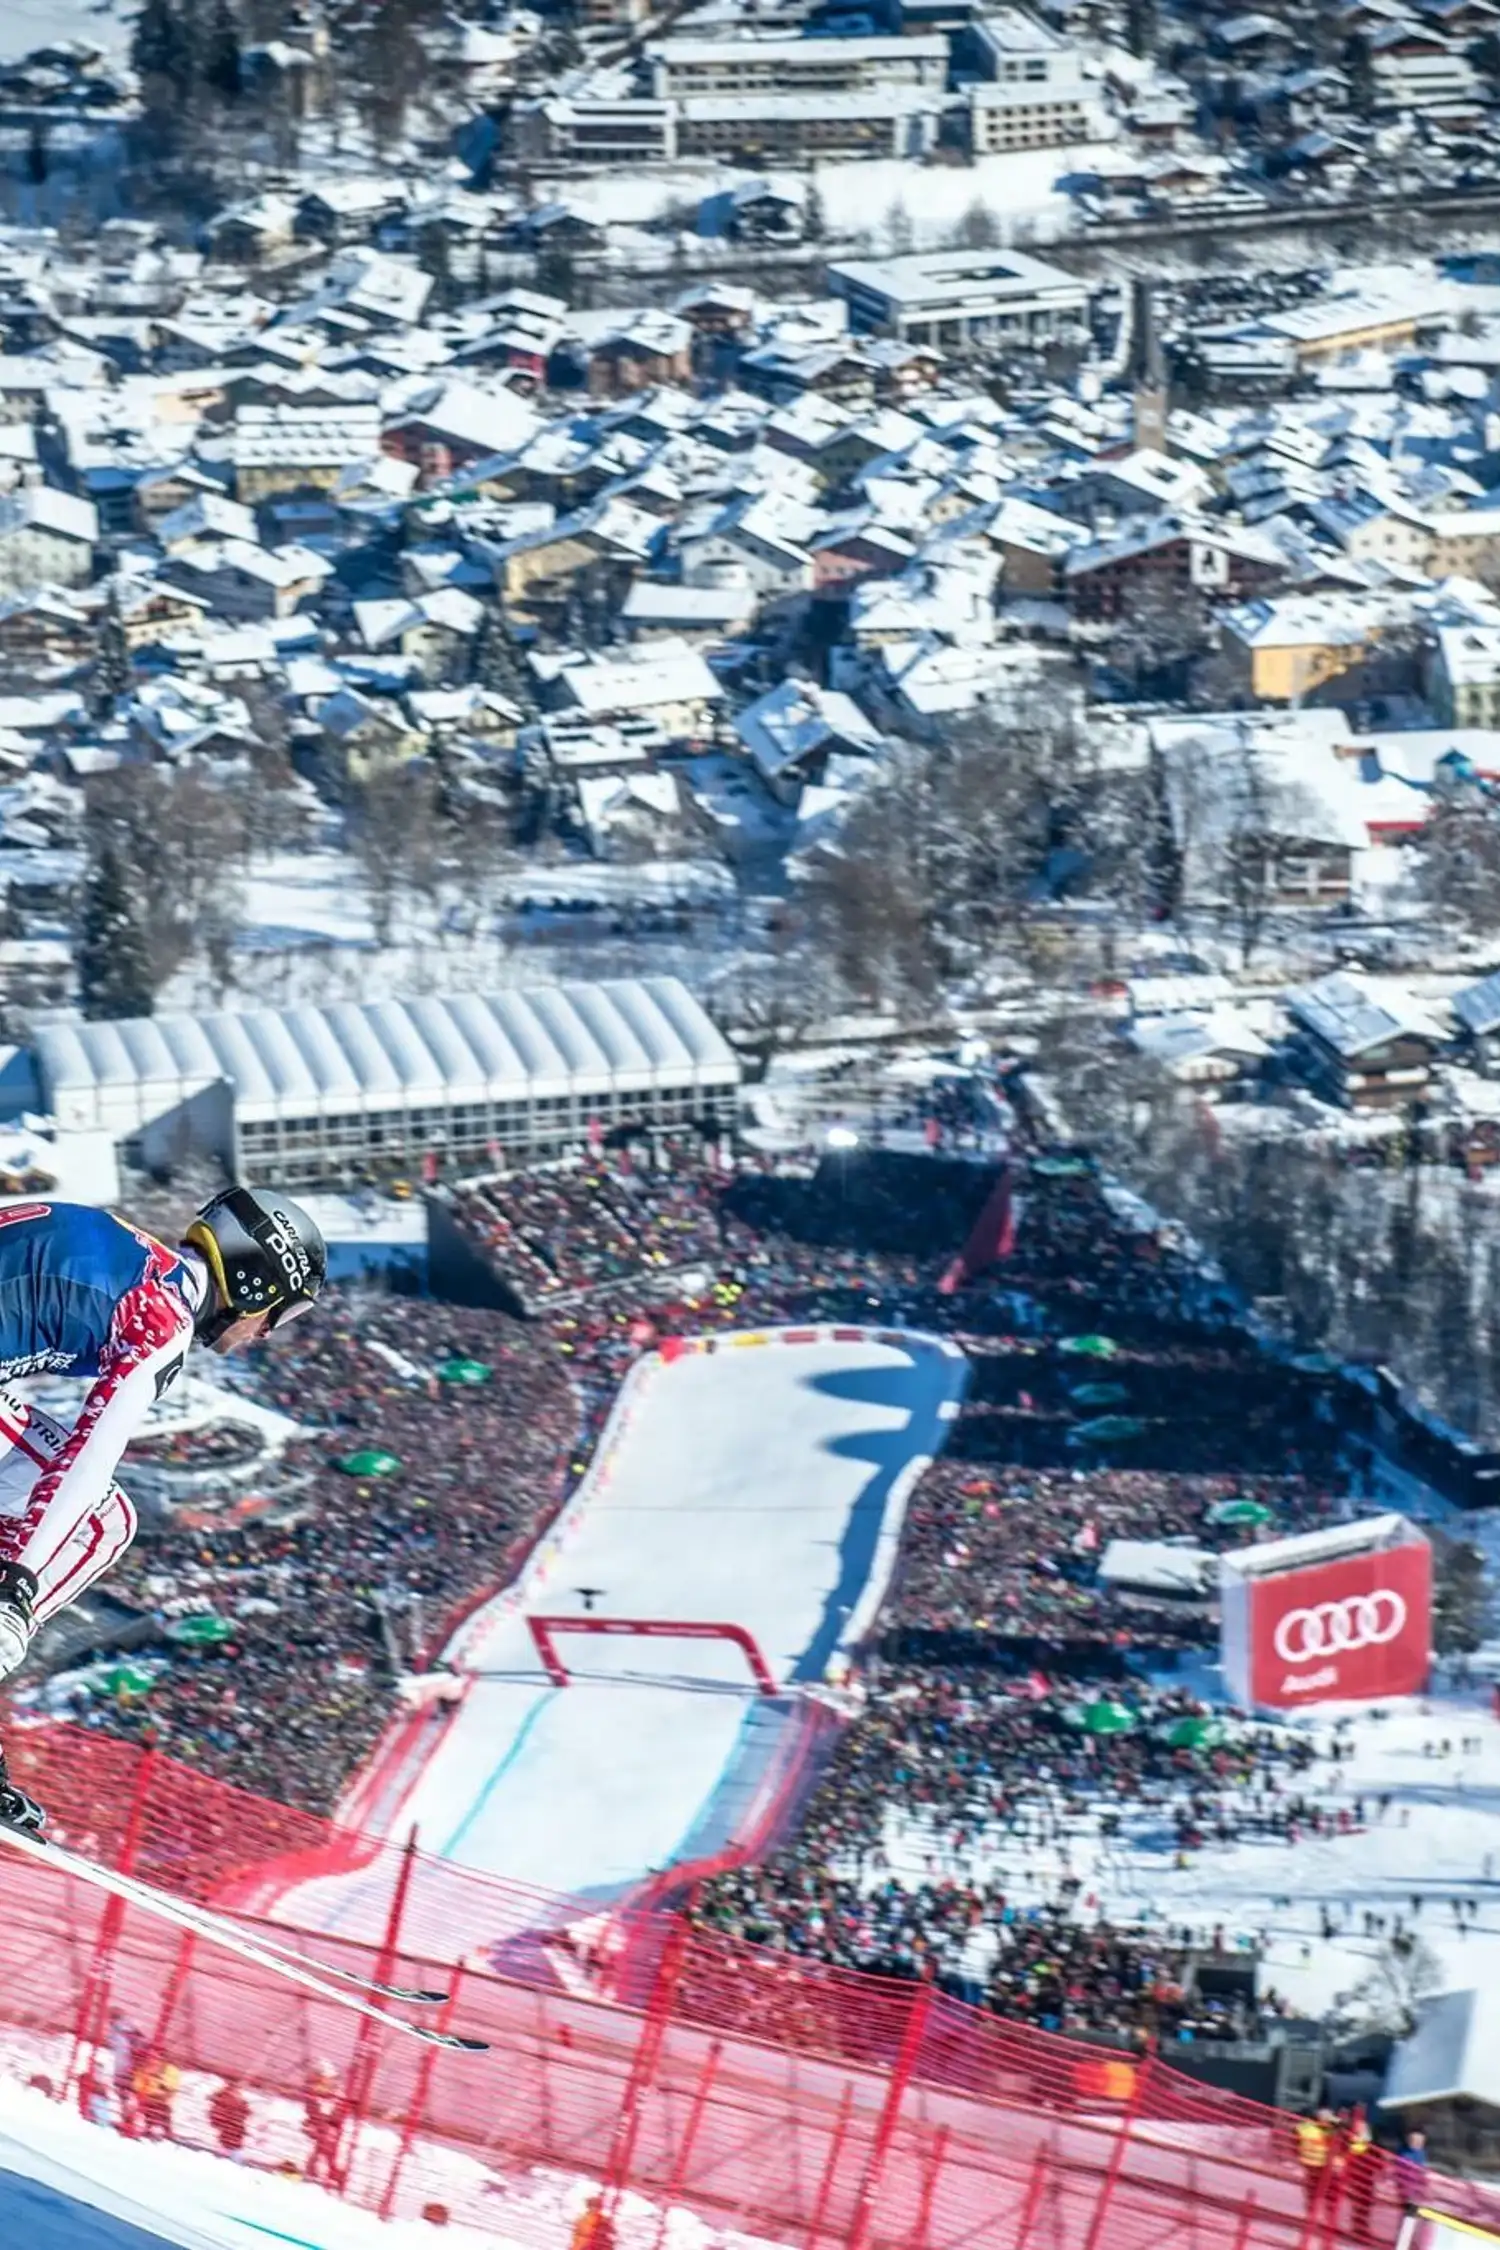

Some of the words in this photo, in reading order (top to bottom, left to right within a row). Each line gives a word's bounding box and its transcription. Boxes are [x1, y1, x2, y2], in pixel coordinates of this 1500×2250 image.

[265, 1233, 303, 1291] POC
[273, 1210, 311, 1276] CARRERA
[1279, 1666, 1338, 1694] Audi
